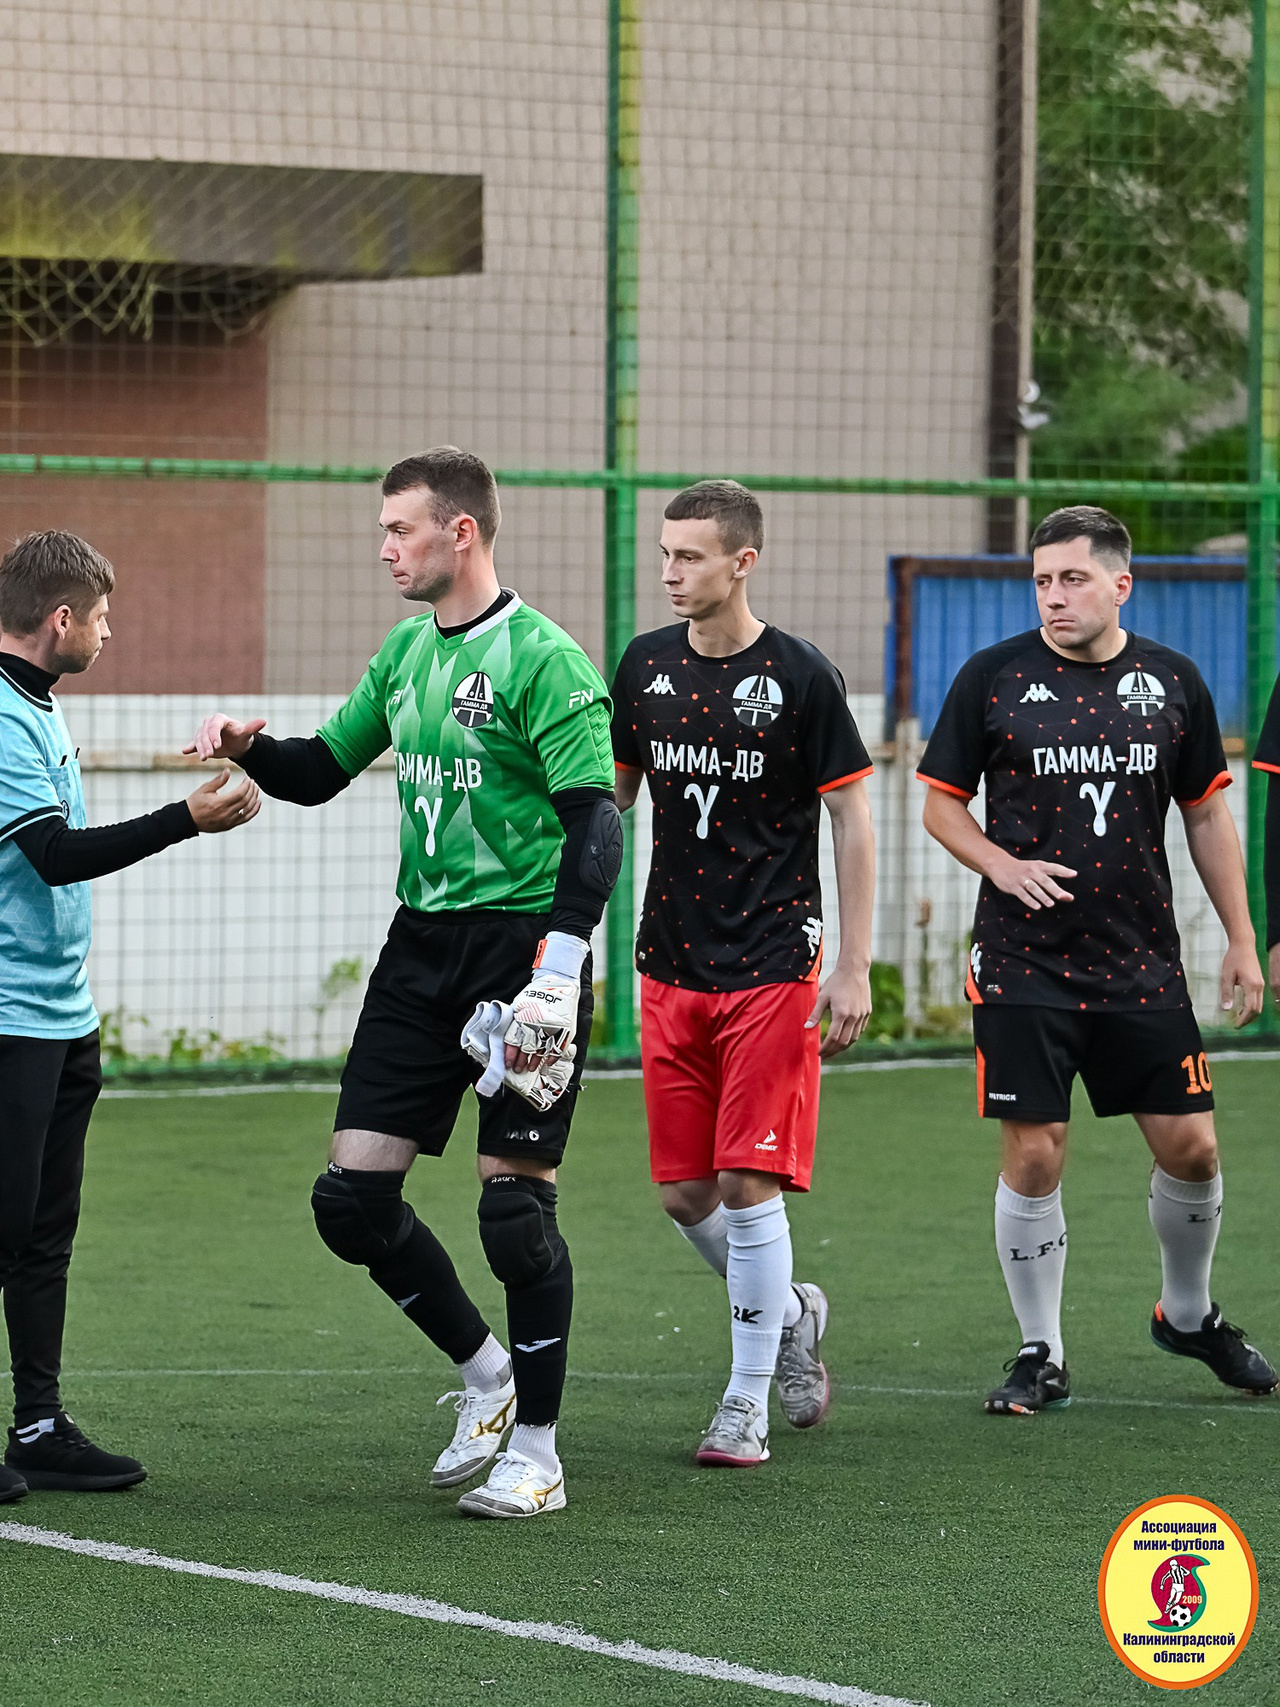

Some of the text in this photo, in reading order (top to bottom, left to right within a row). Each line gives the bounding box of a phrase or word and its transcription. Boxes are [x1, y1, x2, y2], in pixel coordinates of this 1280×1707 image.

[460, 700, 480, 708] ГАММА
[741, 700, 763, 708] ГАММА
[393, 751, 482, 792] ГАММА-ДВ
[650, 740, 765, 782] ГАММА-ДВ
[1032, 743, 1158, 776] ГАММА-ДВ
[1181, 1051, 1213, 1095] 10
